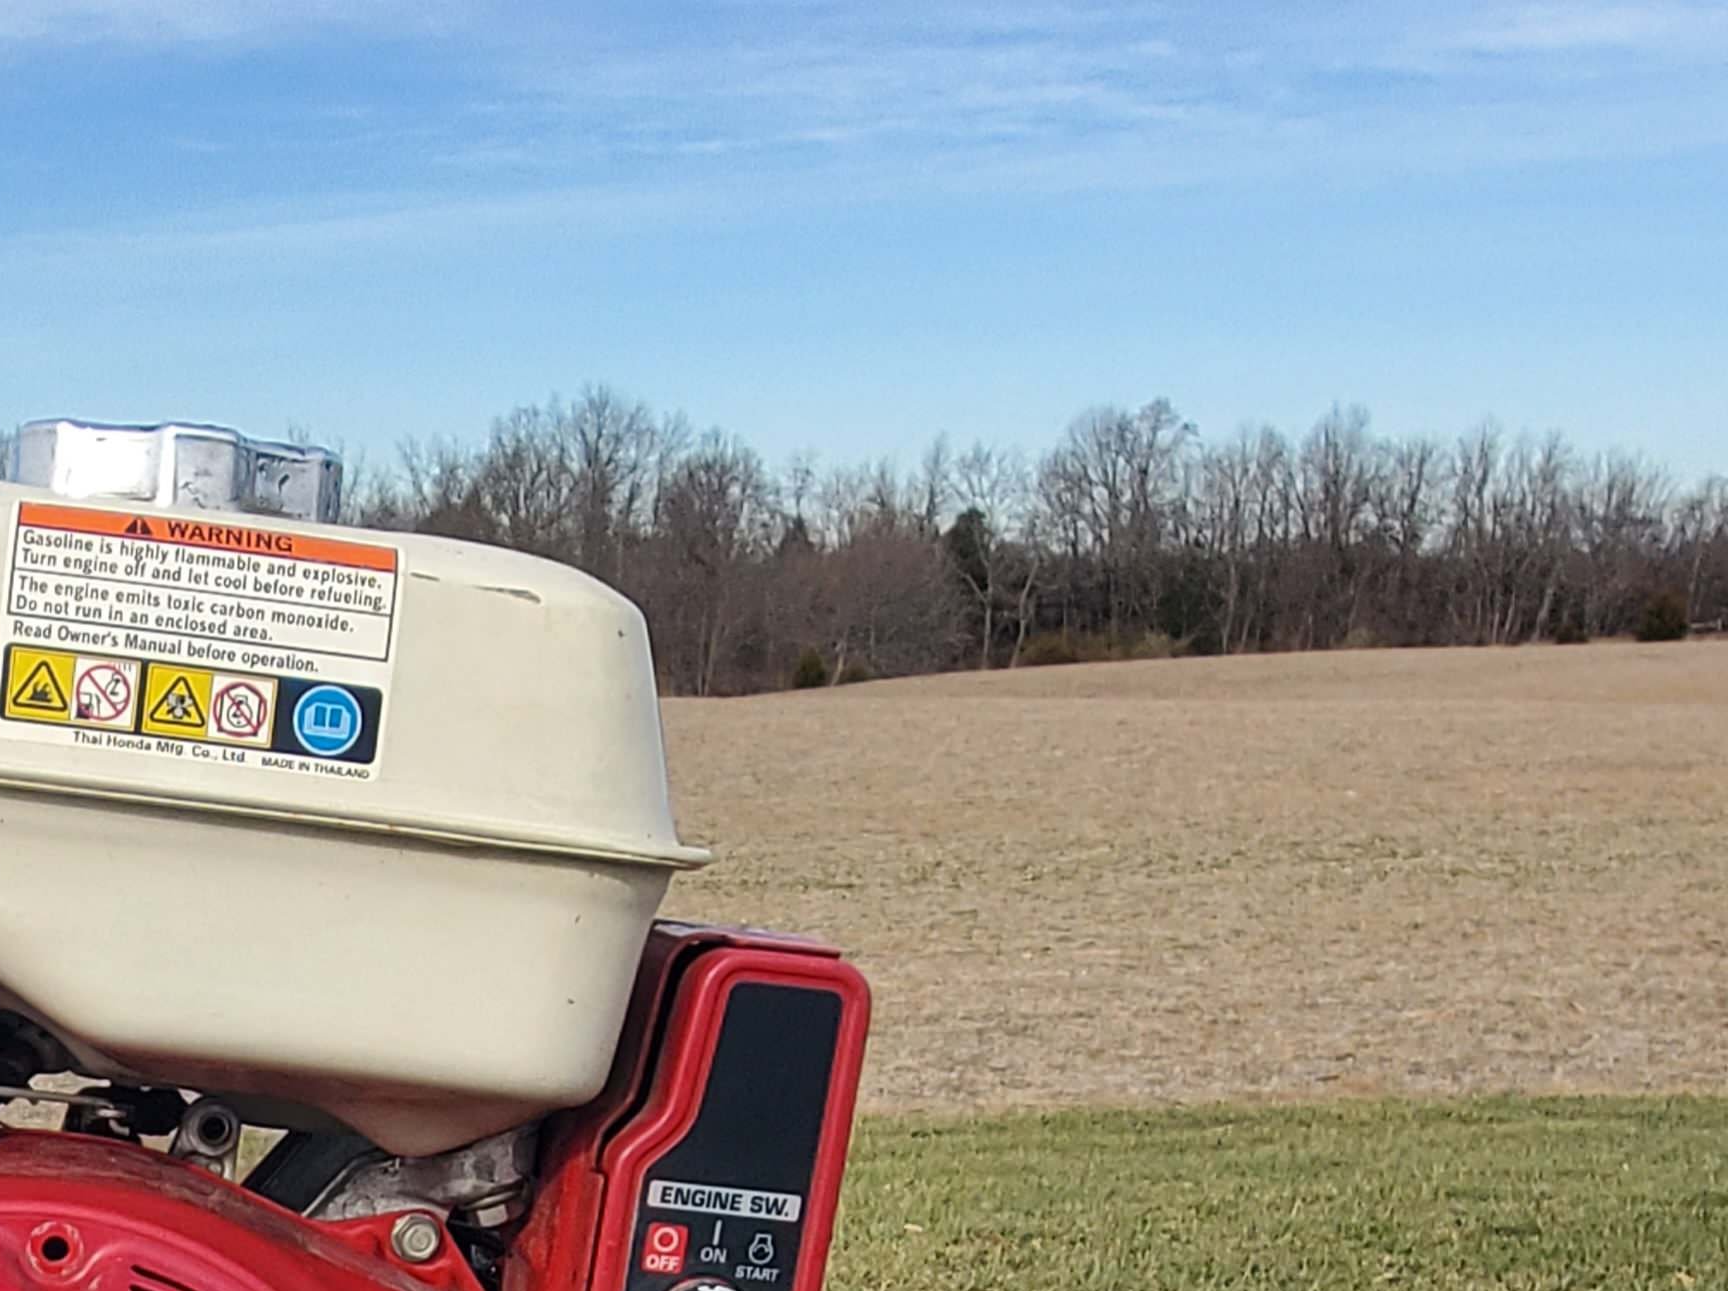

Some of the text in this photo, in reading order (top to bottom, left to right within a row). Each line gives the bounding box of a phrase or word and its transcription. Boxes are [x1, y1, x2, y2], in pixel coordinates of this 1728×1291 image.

[168, 522, 292, 552] WARNING
[23, 529, 381, 589] Gasoline is highly flammable and explosive.
[22, 547, 386, 611] Turn engine off and let cool before refueling.
[16, 594, 272, 640] Do not run in an enclosed area.
[19, 575, 353, 632] The engine emits toxic carbon monoxide.
[13, 620, 318, 672] Read Owner's Manual before operation.
[73, 730, 103, 746] Thai
[106, 734, 152, 751] Honda
[261, 757, 370, 780] MADE IN THAILAND
[659, 1186, 790, 1217] ENGINE SW.
[645, 1254, 681, 1271] OFF
[700, 1247, 727, 1263] ON
[735, 1265, 780, 1282] START
